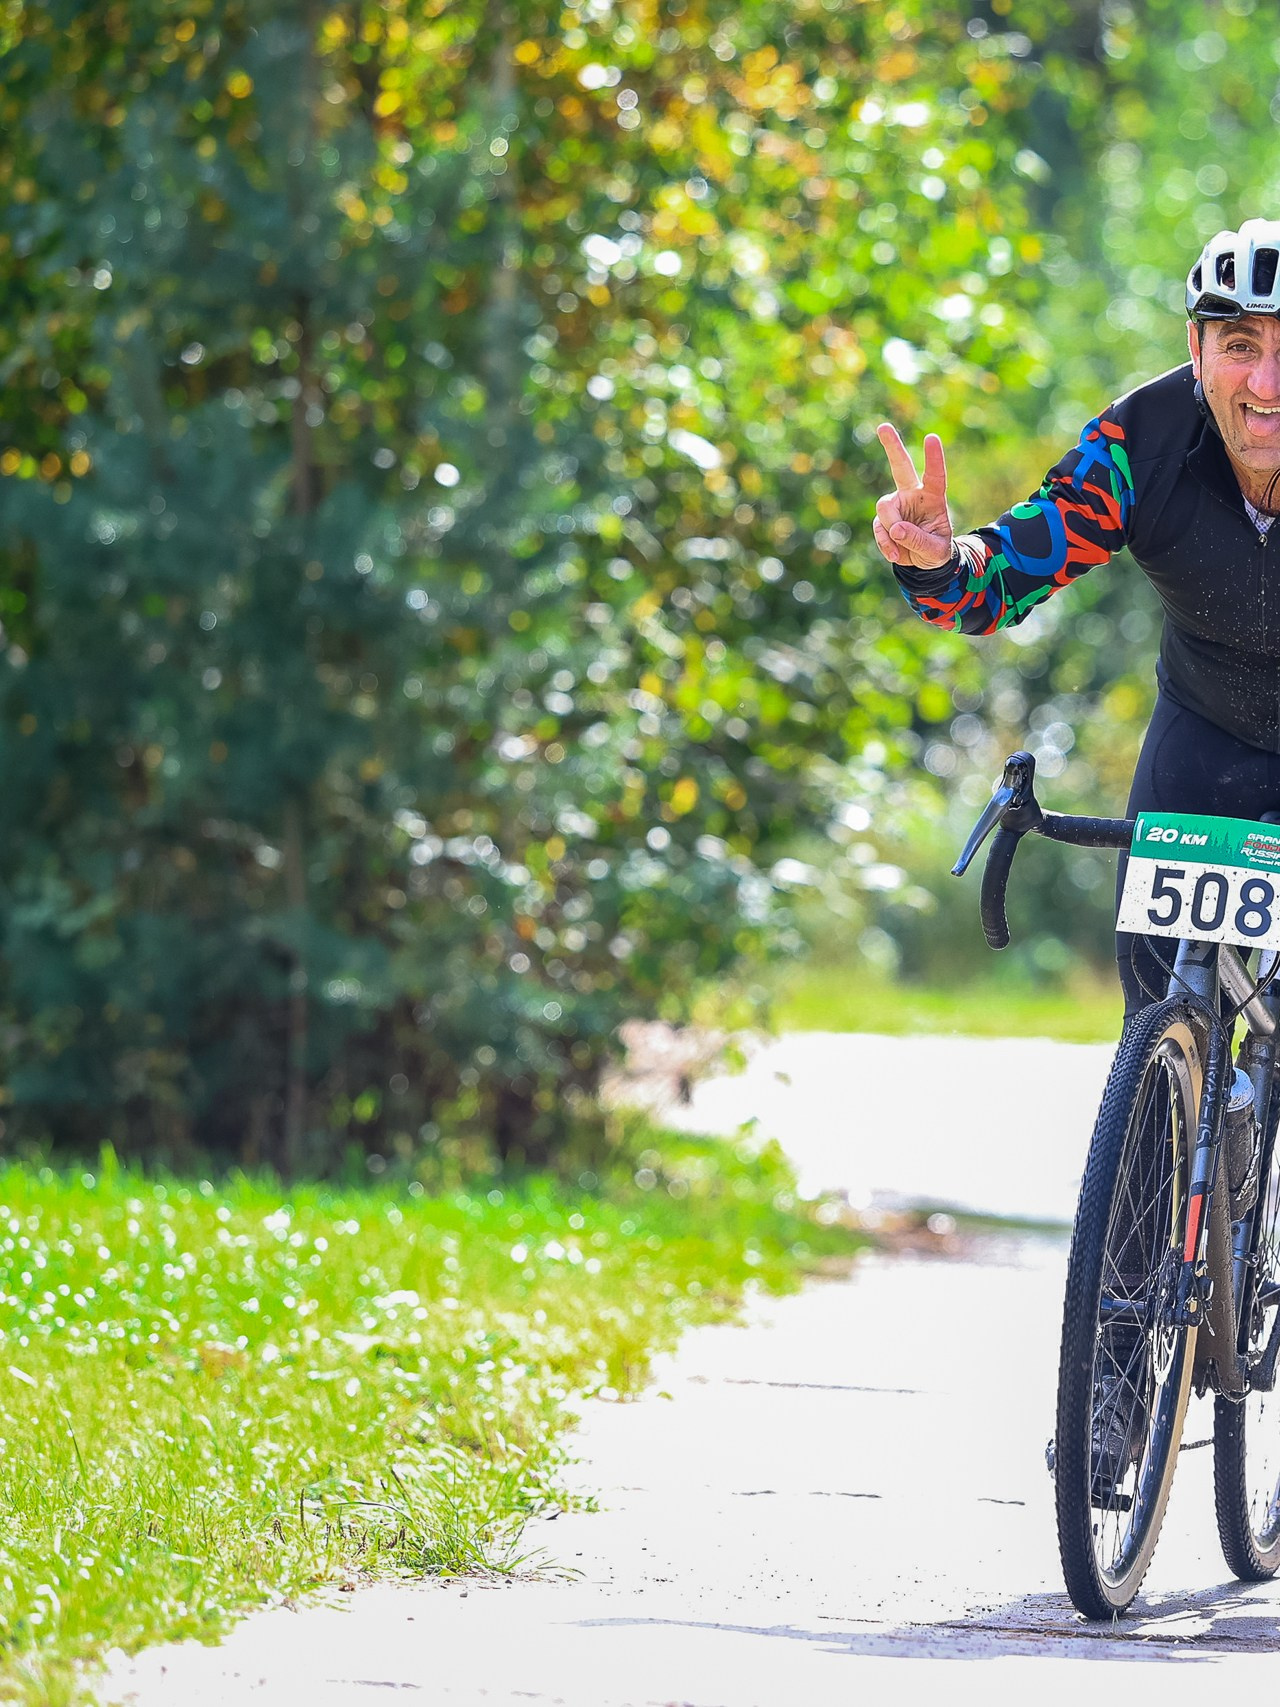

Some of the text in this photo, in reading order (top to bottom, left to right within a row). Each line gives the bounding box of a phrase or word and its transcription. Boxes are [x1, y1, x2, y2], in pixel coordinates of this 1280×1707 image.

[1146, 826, 1209, 846] 20 KM
[1147, 867, 1275, 938] 508
